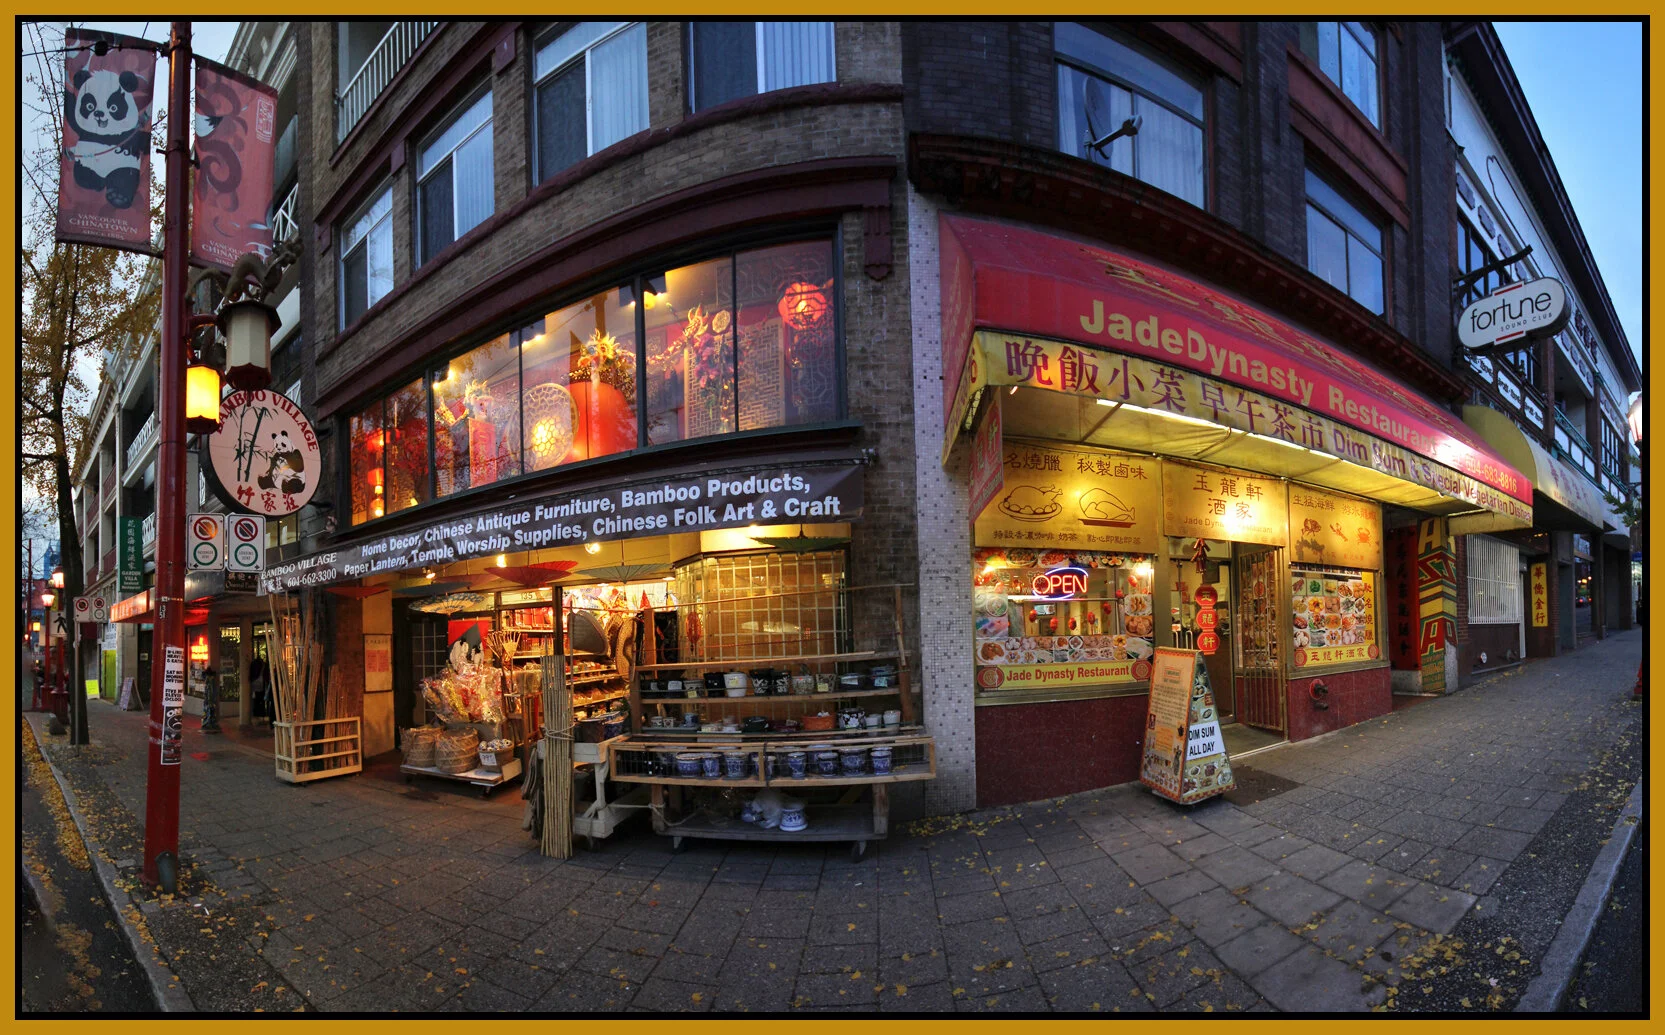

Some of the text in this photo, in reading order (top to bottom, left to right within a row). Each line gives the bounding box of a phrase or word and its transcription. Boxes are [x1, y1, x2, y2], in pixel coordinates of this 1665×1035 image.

[69, 217, 138, 234] CHINATOWN
[78, 213, 128, 226] VANCOUVER
[201, 243, 240, 261] CHINAT
[1470, 292, 1552, 333] fortune
[1500, 312, 1553, 332] SOUND CLUB
[272, 393, 319, 452] VILLAGE
[1328, 384, 1438, 457] Restaurant
[1333, 428, 1368, 461] Dim
[1421, 463, 1460, 494] Special
[362, 473, 811, 557] Home Decor, Chinese Antique Furniture, Bamboo Products,
[1183, 516, 1203, 526] Jade
[344, 495, 841, 578] Paper Lantern, Temple Worship Supplies, Chinese Folk Art & Craft
[261, 563, 296, 580] BAMBOO
[297, 552, 338, 571] VILLAGE
[1032, 574, 1088, 595] OPEN
[1006, 665, 1130, 682] Jade Dynasty Restaurant
[1188, 726, 1215, 740] DIM SUM
[1189, 741, 1215, 756] ALL DAY
